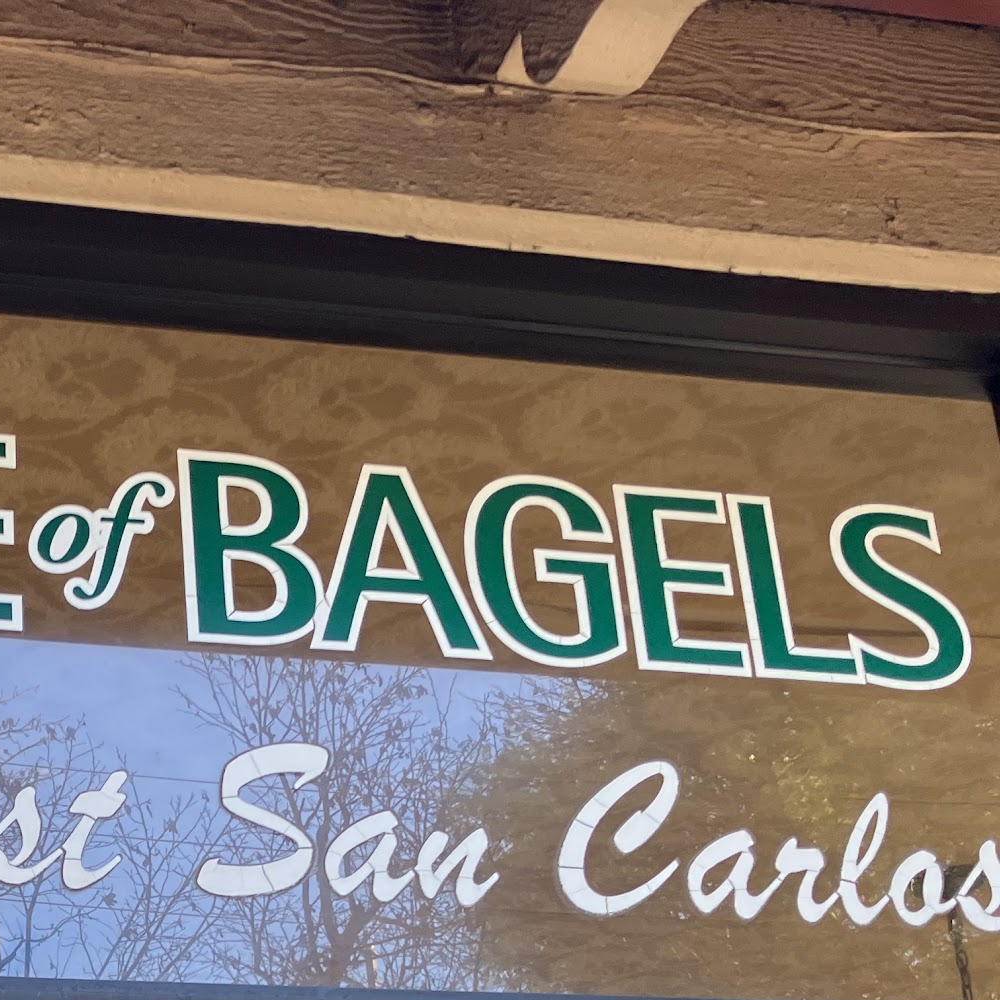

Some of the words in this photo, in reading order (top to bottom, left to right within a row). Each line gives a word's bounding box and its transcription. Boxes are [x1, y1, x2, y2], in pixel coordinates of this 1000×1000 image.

[28, 471, 174, 611] of
[177, 448, 972, 690] BAGELS
[198, 742, 499, 907] San
[558, 760, 1000, 932] Carlos
